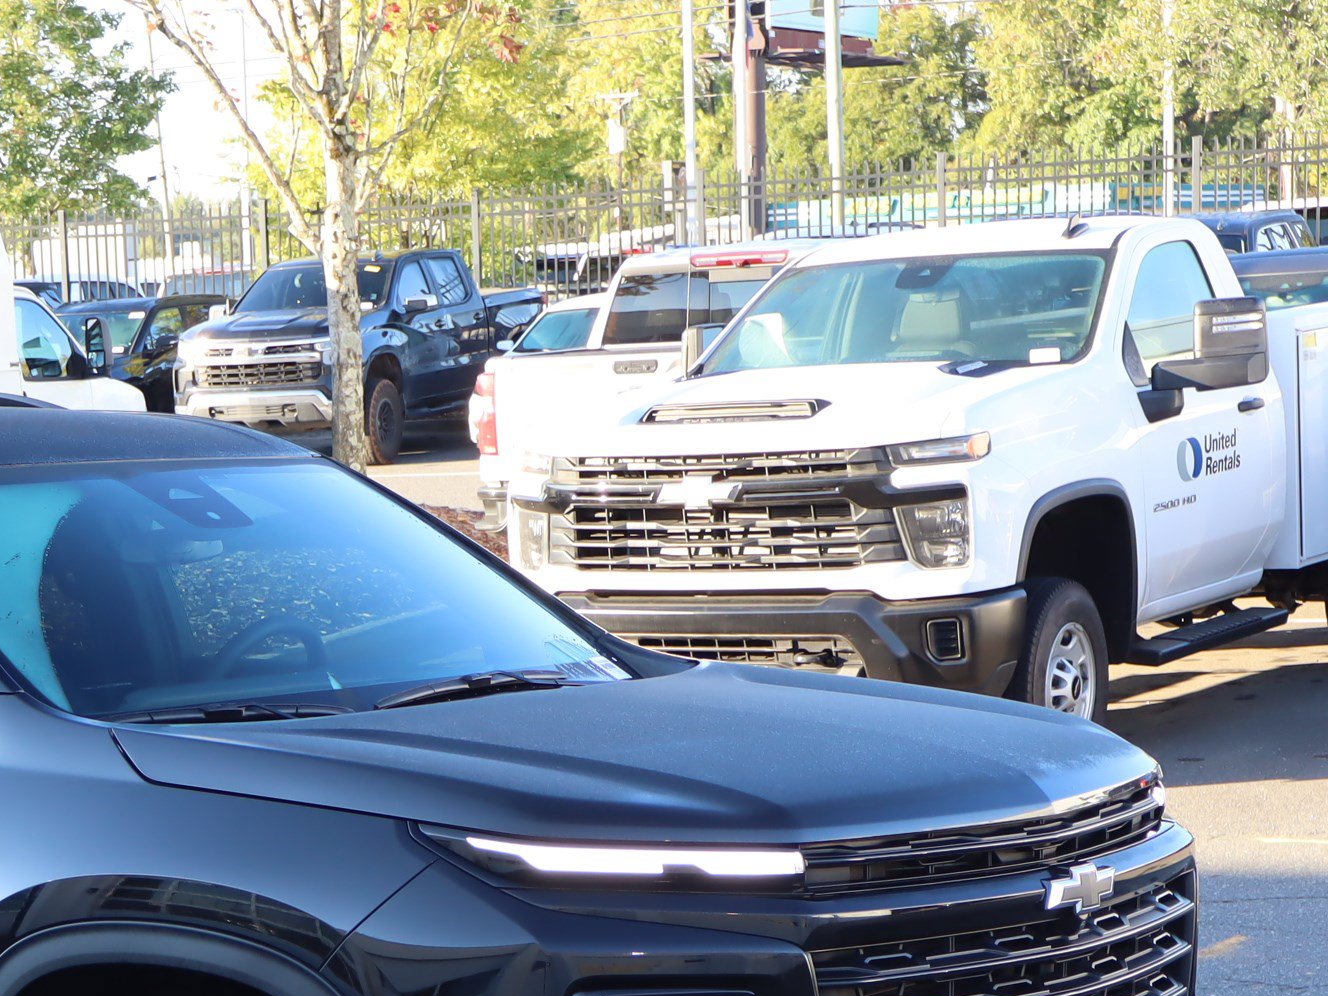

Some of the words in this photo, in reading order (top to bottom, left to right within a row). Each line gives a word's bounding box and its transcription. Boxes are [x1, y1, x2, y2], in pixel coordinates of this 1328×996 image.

[1204, 427, 1237, 453] United
[1205, 450, 1241, 476] Rentals
[1153, 498, 1180, 513] 2500
[1182, 494, 1197, 505] HD
